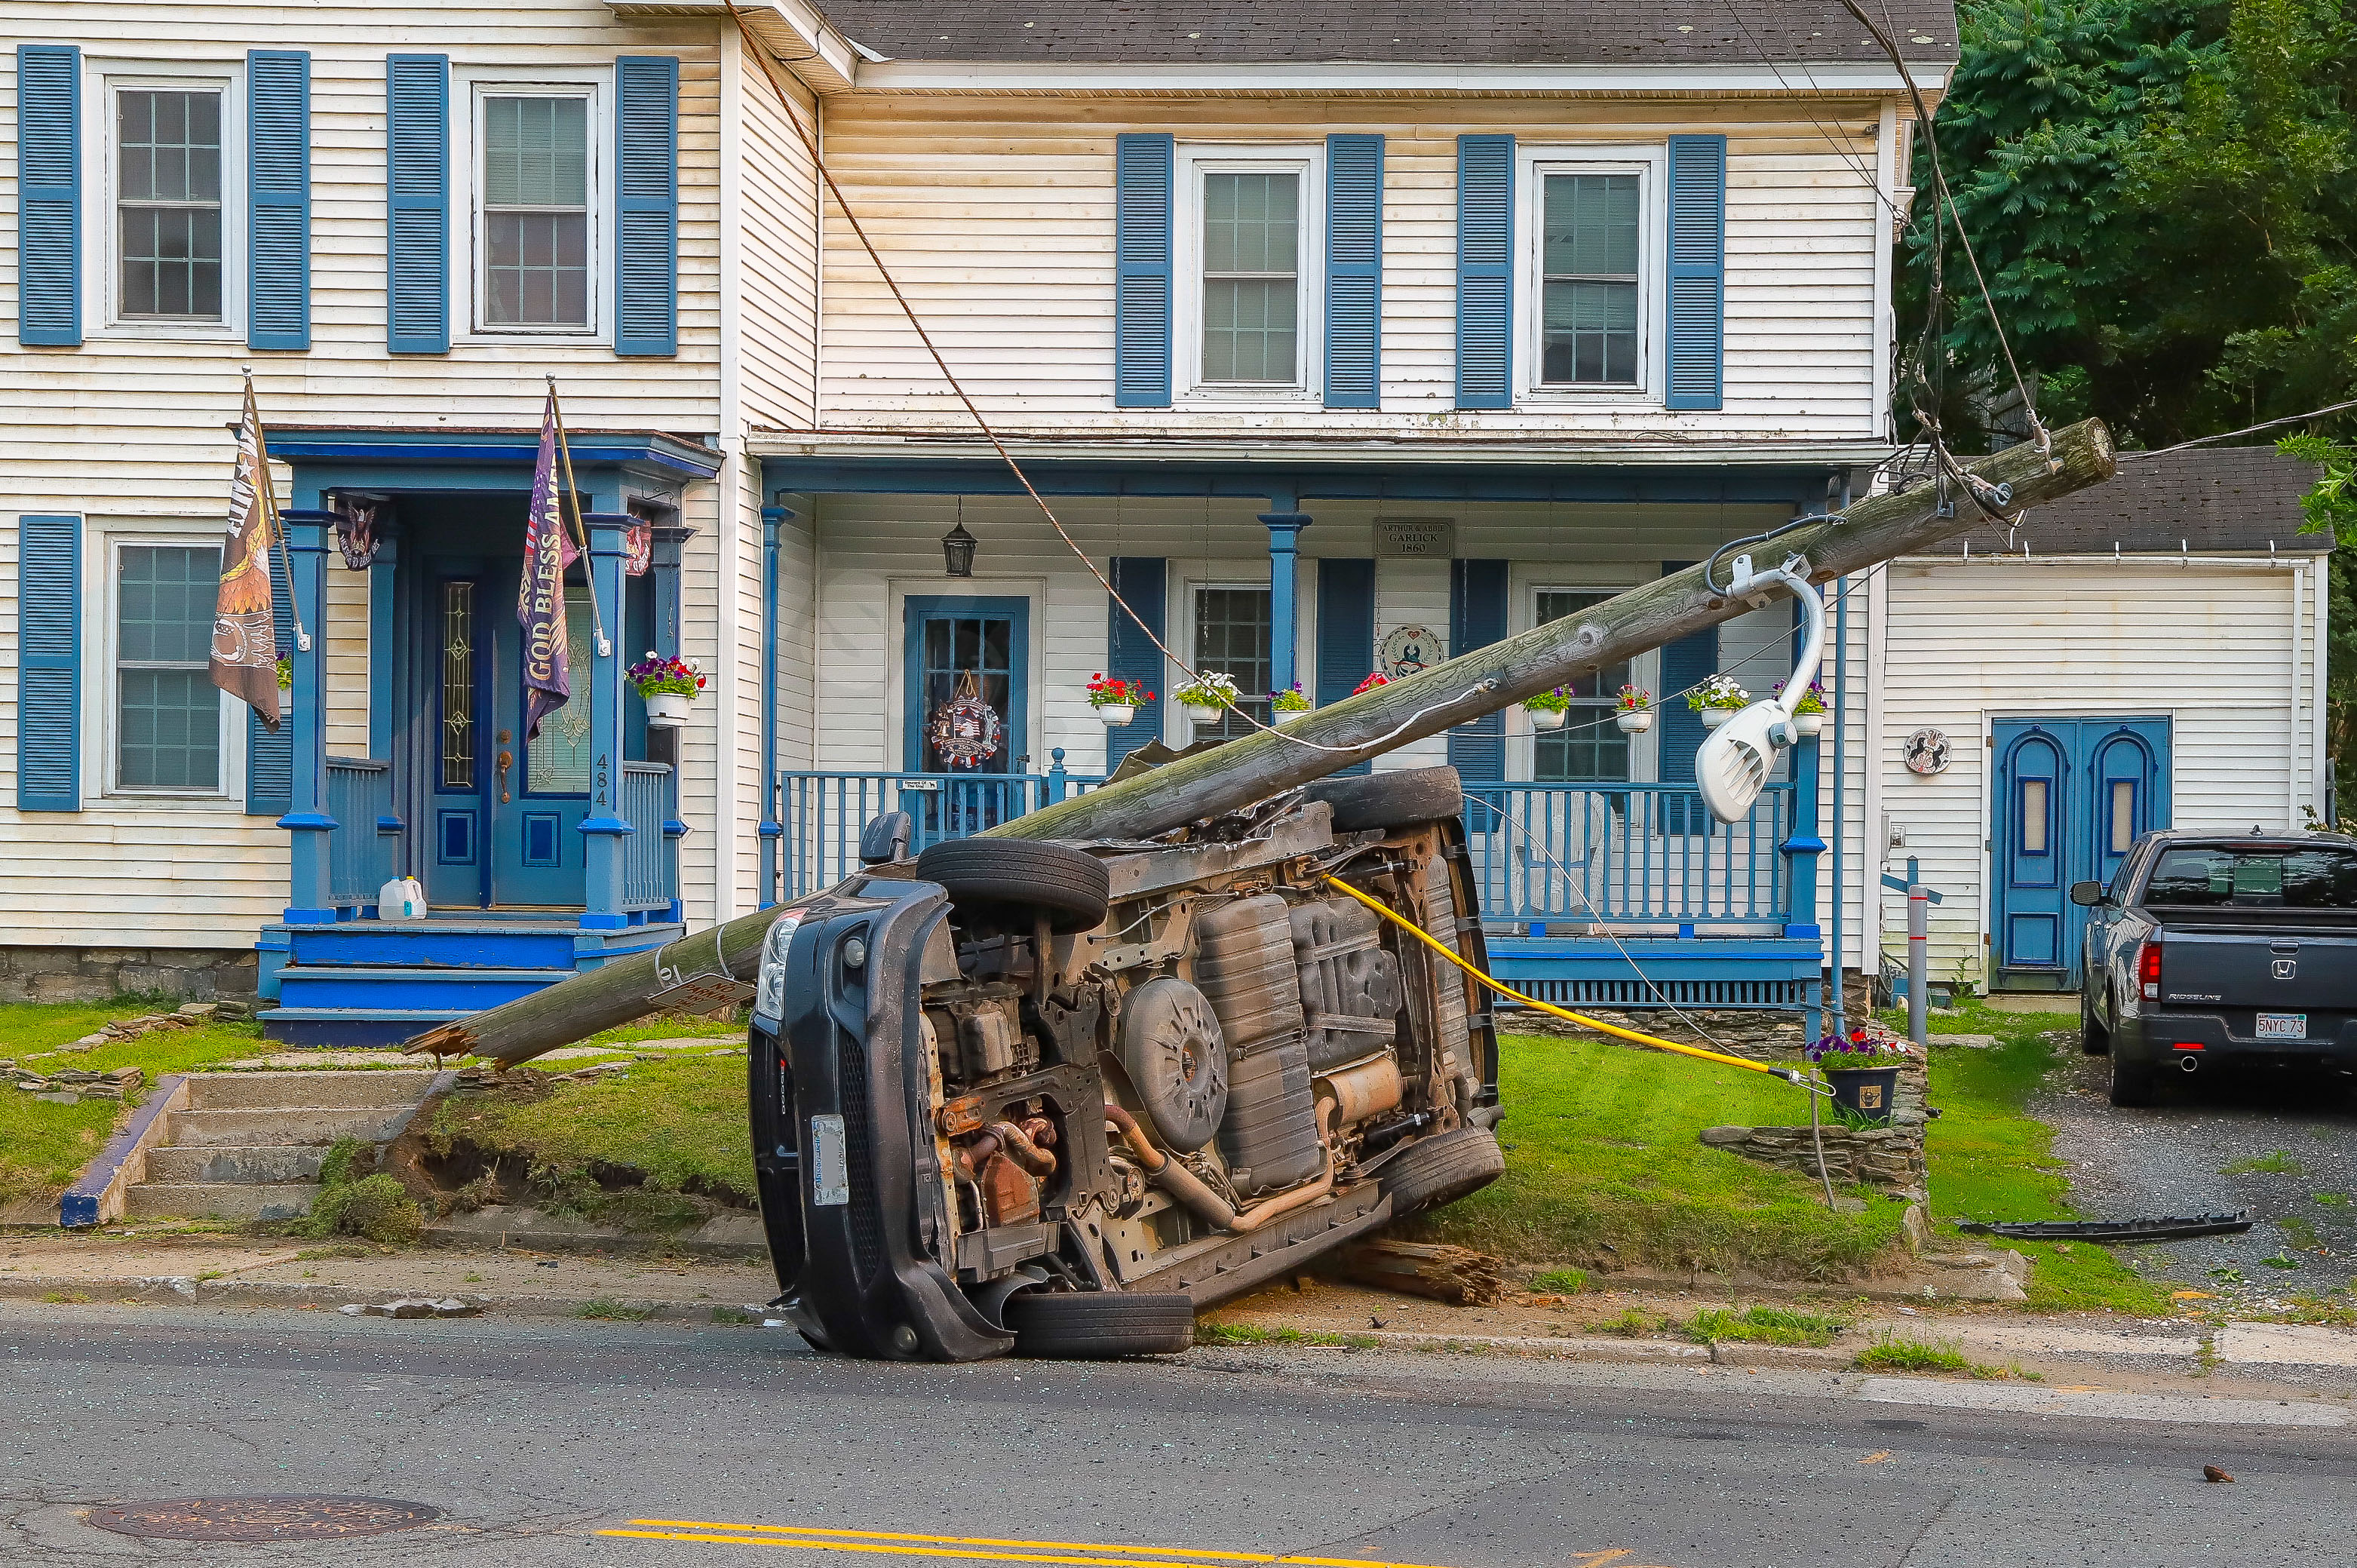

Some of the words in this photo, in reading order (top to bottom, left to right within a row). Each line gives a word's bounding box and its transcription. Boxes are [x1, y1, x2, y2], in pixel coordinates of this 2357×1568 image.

[1389, 533, 1438, 542] GARLICK
[1401, 544, 1426, 553] 1860
[534, 532, 562, 615] BLESS
[529, 621, 552, 681] GOD
[596, 753, 609, 806] 484
[680, 983, 738, 1003] PARKING
[709, 982, 737, 993] NO
[683, 994, 708, 1002] ANY
[2258, 1019, 2287, 1033] 5NYC
[2290, 1020, 2304, 1033] 73
